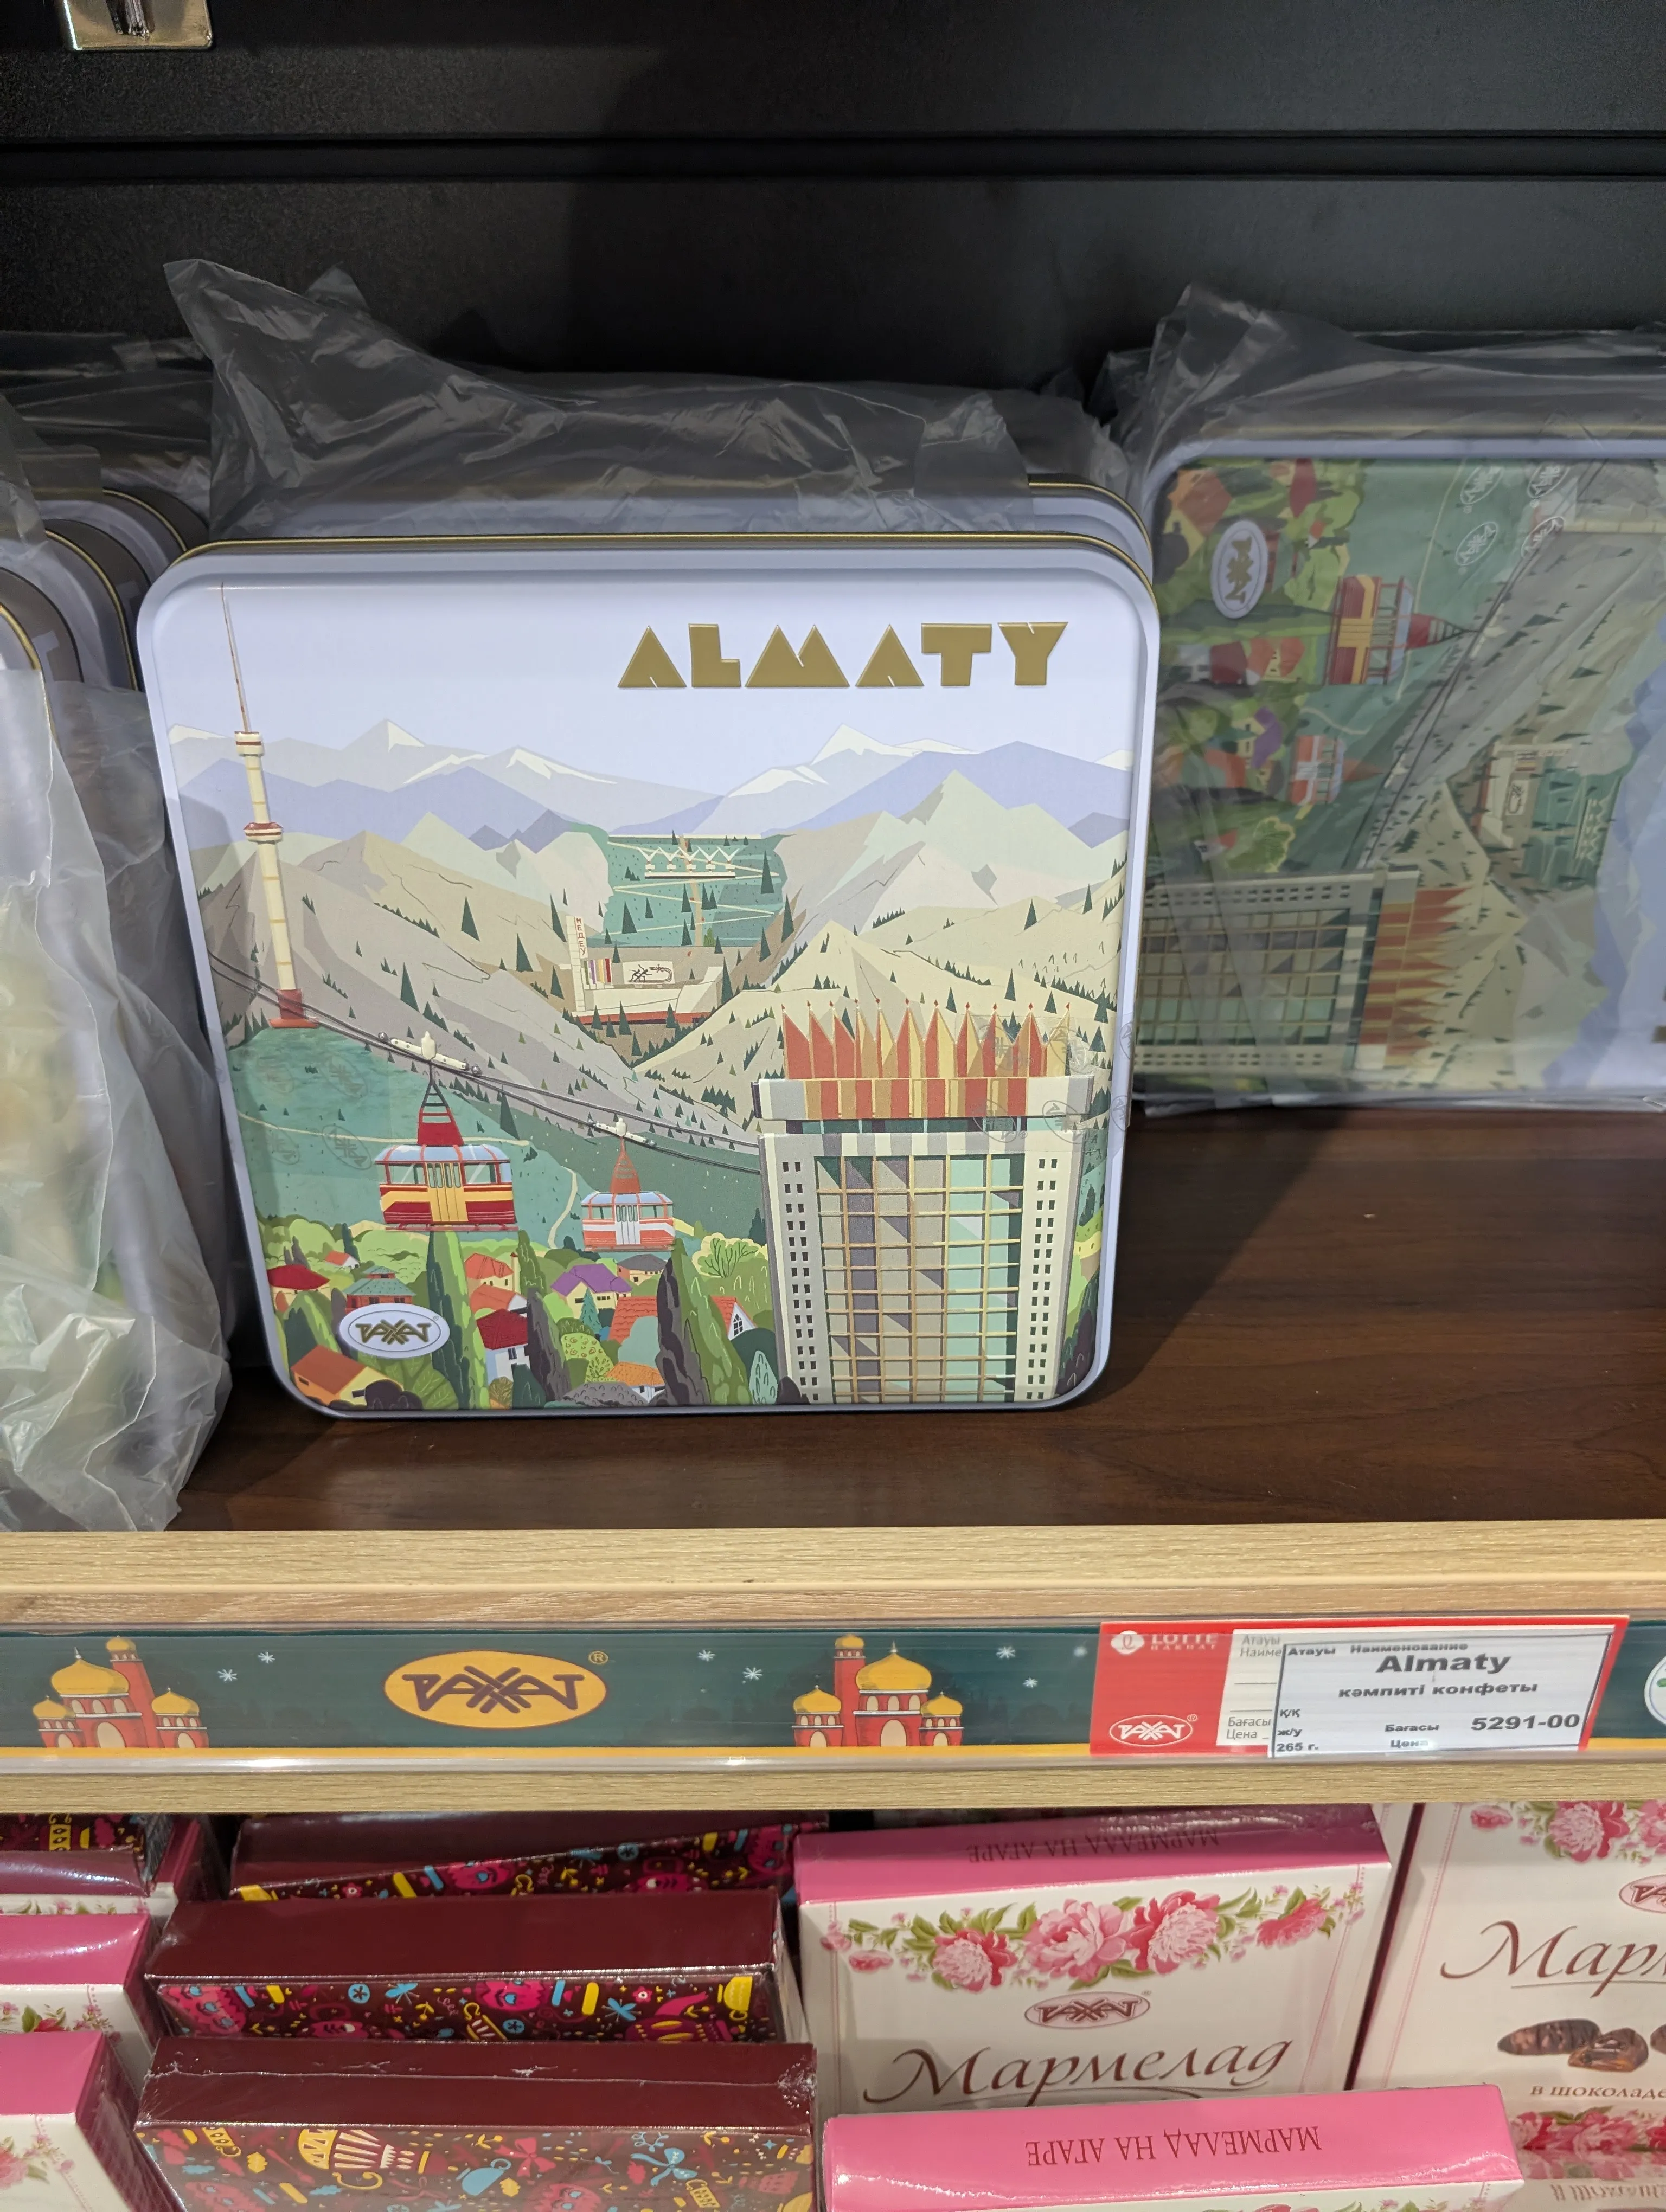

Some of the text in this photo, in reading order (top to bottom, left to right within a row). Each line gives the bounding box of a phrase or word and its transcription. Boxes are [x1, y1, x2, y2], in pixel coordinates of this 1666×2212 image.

[617, 622, 1069, 689] ALMATY
[576, 917, 586, 956] МЕДЕУ
[1241, 1635, 1280, 1646] Атауы
[1287, 1643, 1468, 1656] Атауы Наименование
[1375, 1653, 1511, 1674] Almaty
[1338, 1682, 1539, 1697] кәмпиті конфеты
[1228, 1717, 1271, 1727] Бағасы
[1385, 1714, 1580, 1732] Бағасы 5291-00
[1227, 1729, 1257, 1740] Цена
[1276, 1742, 1303, 1752] 265
[969, 1829, 1220, 1863] МАРМЕЛАД НА АГАРЕ
[863, 2041, 1293, 2107] Мармелад
[1530, 2085, 1543, 2095] в
[1025, 2126, 1322, 2166] МАРМЕЛАД НА АГАРЕ
